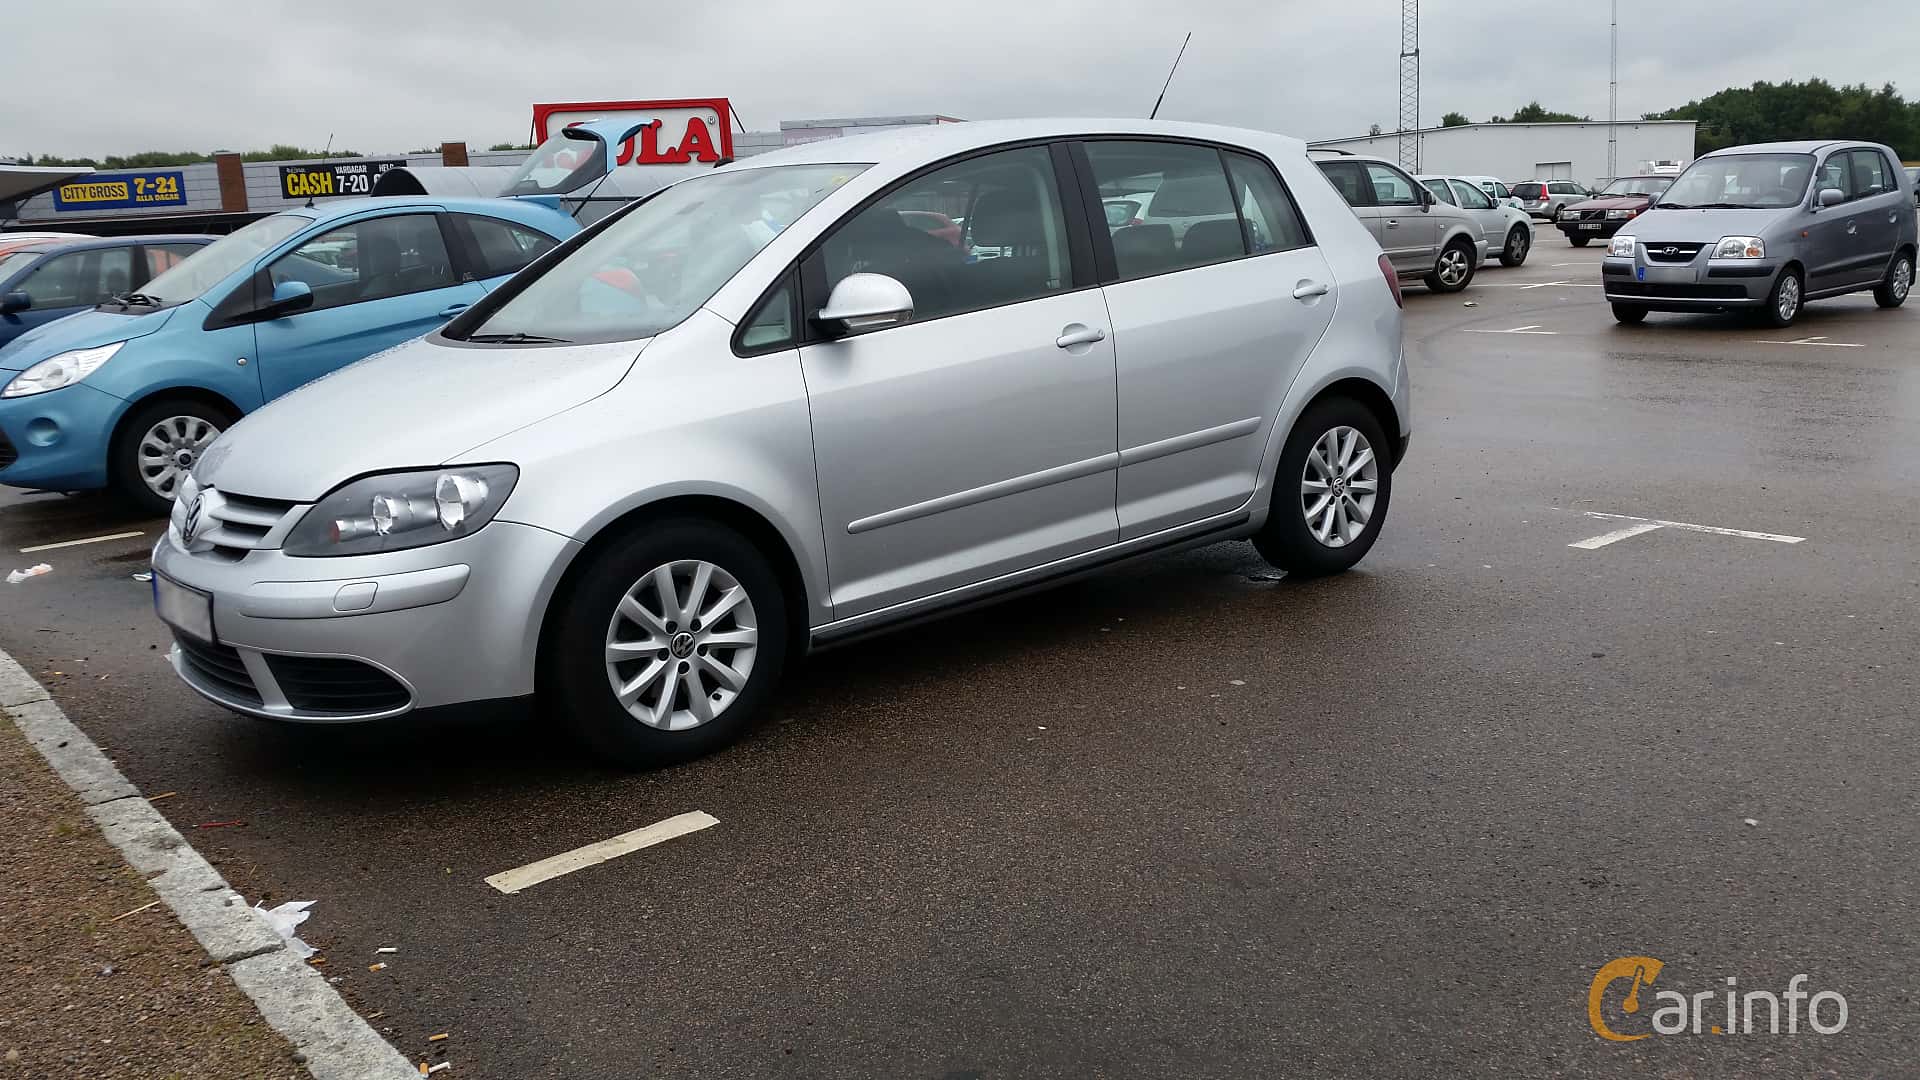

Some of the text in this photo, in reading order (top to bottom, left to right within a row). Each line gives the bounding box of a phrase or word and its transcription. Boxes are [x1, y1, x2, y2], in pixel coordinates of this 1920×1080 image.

[335, 164, 368, 174] VARDAGAR
[63, 184, 126, 200] CITY GROSS
[133, 176, 178, 194] 7-21
[286, 171, 334, 196] CASH
[336, 174, 369, 193] 7-20
